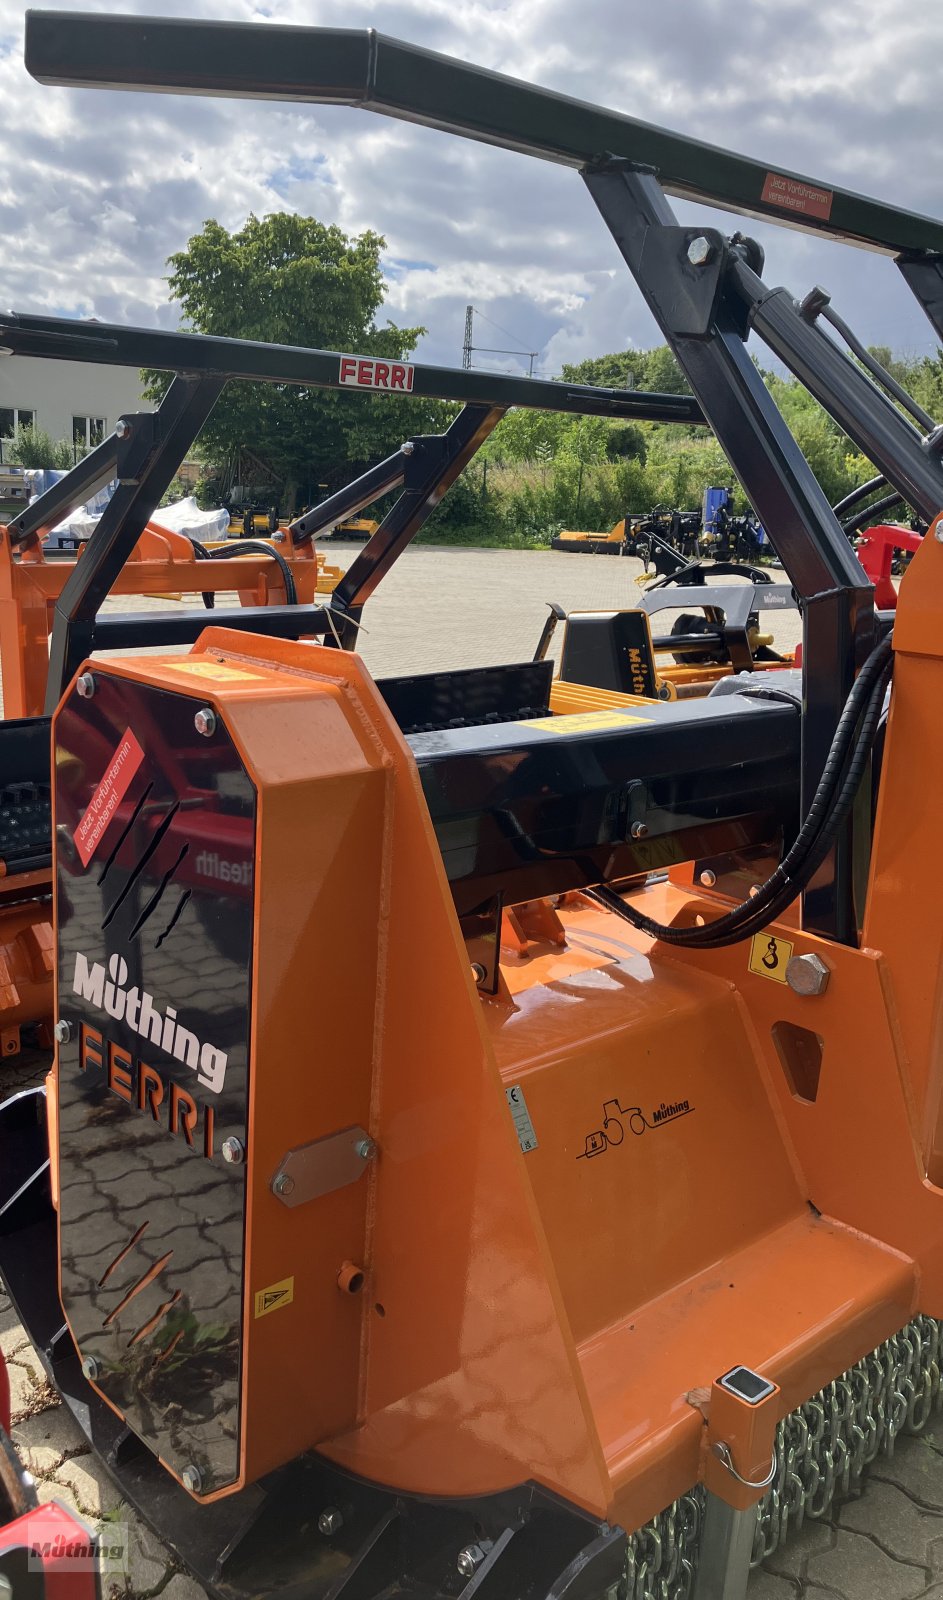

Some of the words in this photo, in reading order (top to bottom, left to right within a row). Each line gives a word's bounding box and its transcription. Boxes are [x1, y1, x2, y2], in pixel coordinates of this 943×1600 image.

[770, 177, 786, 191] Jetzt
[787, 182, 829, 204] Vorführtermin
[341, 358, 414, 389] FERRI
[79, 812, 95, 841] Jetzt
[91, 741, 131, 814] Vorführtermin
[84, 788, 120, 853] vereinbaren!
[73, 951, 228, 1094] Müthing
[78, 1019, 215, 1161] FERRI
[652, 1100, 690, 1123] Müthing
